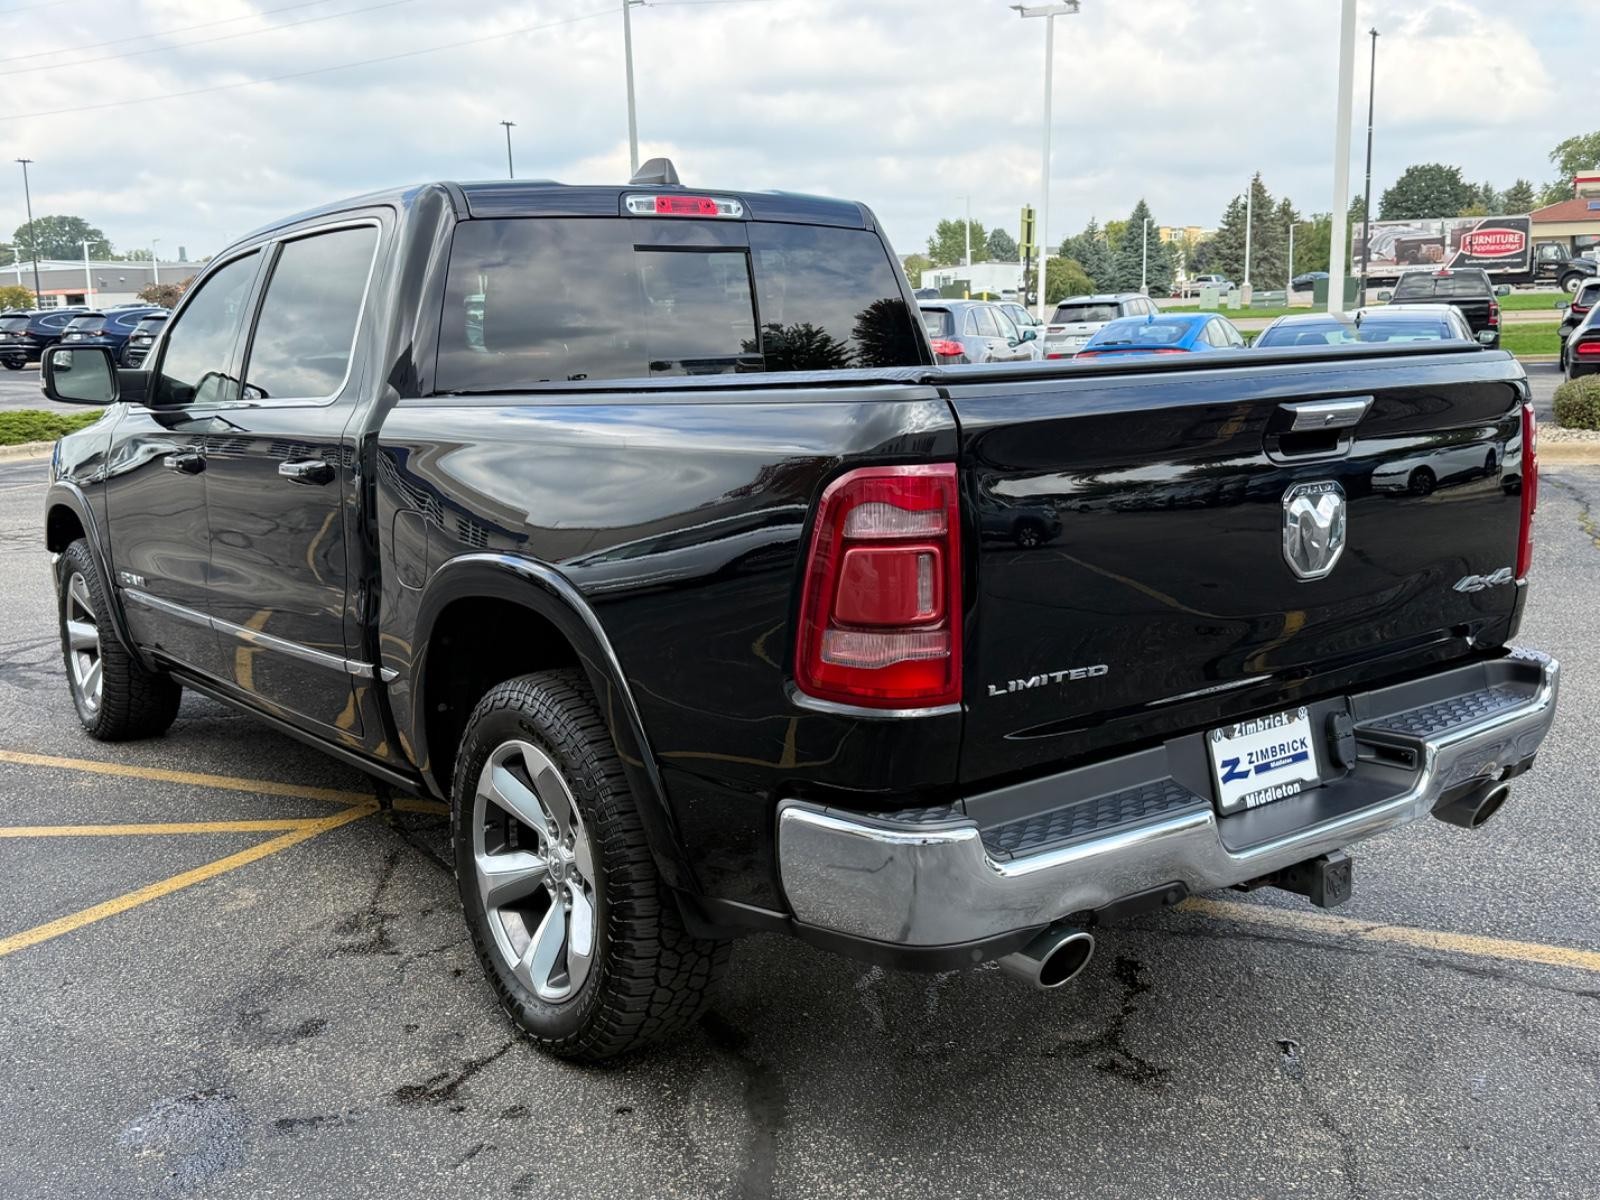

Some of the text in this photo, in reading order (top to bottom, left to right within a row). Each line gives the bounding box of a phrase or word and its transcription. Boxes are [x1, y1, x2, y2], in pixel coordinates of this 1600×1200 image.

[1465, 233, 1521, 244] FURNITURE
[988, 664, 1109, 697] LIMITED
[1233, 712, 1289, 737] Zimbrick
[1247, 737, 1308, 765] ZIMBRICK
[1245, 783, 1301, 808] Middleton
